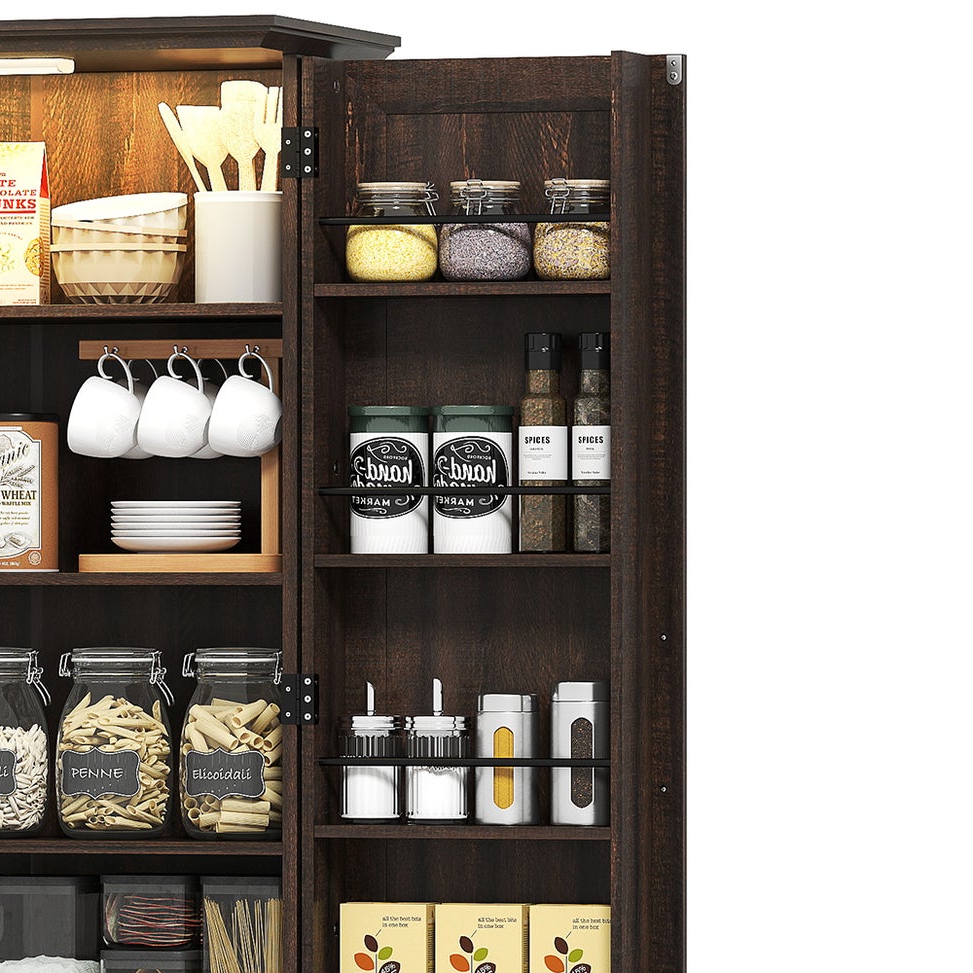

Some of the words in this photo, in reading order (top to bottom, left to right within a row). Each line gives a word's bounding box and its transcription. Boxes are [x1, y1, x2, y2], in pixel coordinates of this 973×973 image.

[525, 436, 550, 444] SPICES
[578, 436, 603, 444] SPICES
[1, 490, 37, 500] WHEAT
[71, 767, 123, 779] PENNE
[192, 767, 253, 781] Elicoidali
